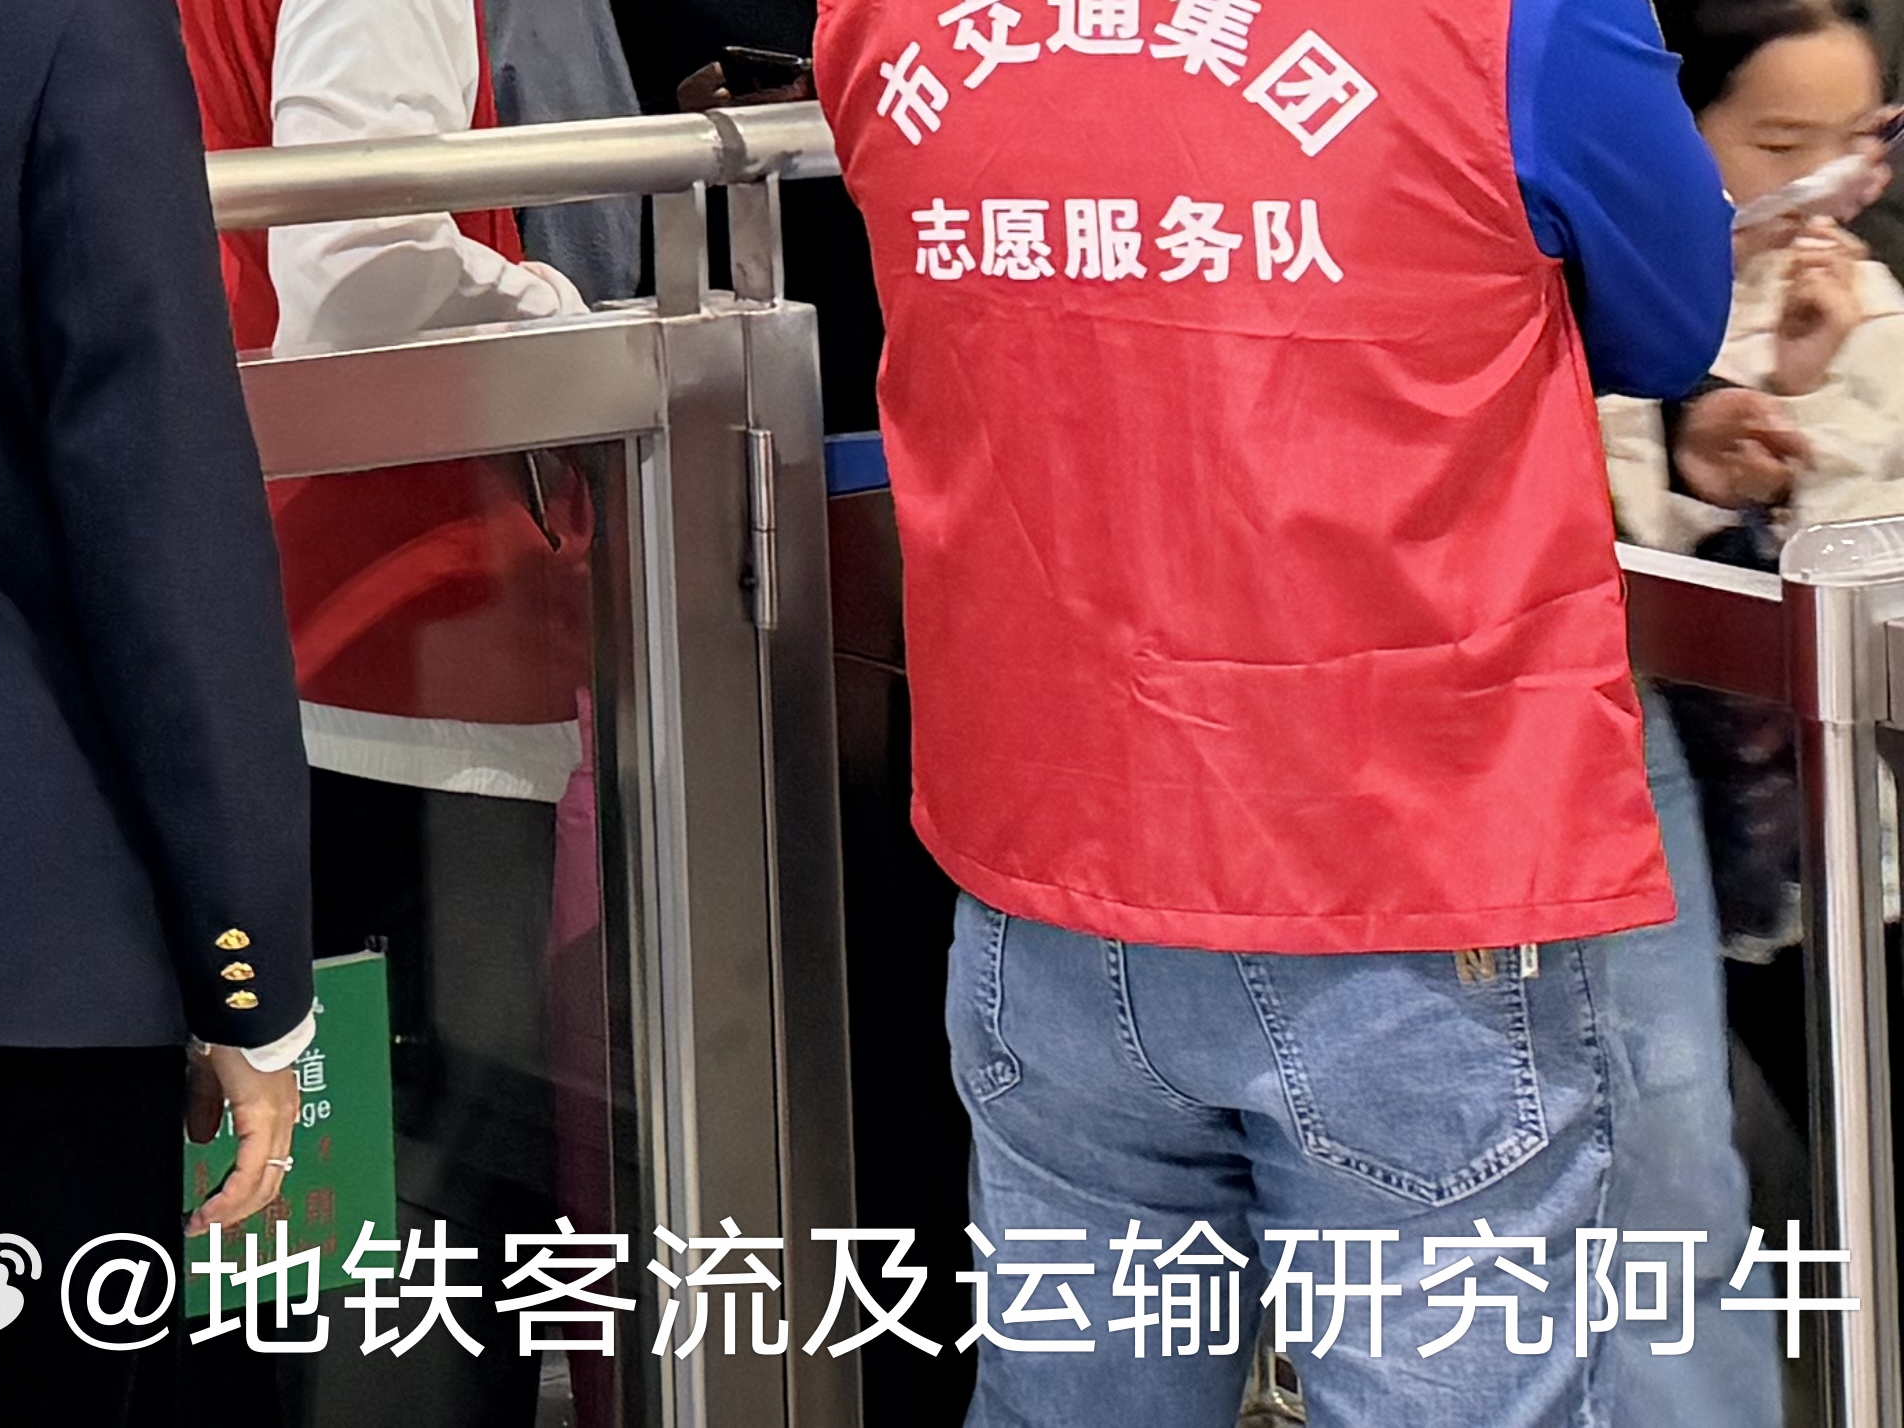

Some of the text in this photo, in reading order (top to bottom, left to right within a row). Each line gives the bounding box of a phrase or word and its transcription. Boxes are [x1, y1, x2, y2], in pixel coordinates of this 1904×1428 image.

[911, 194, 1344, 284] 志愿服务队
